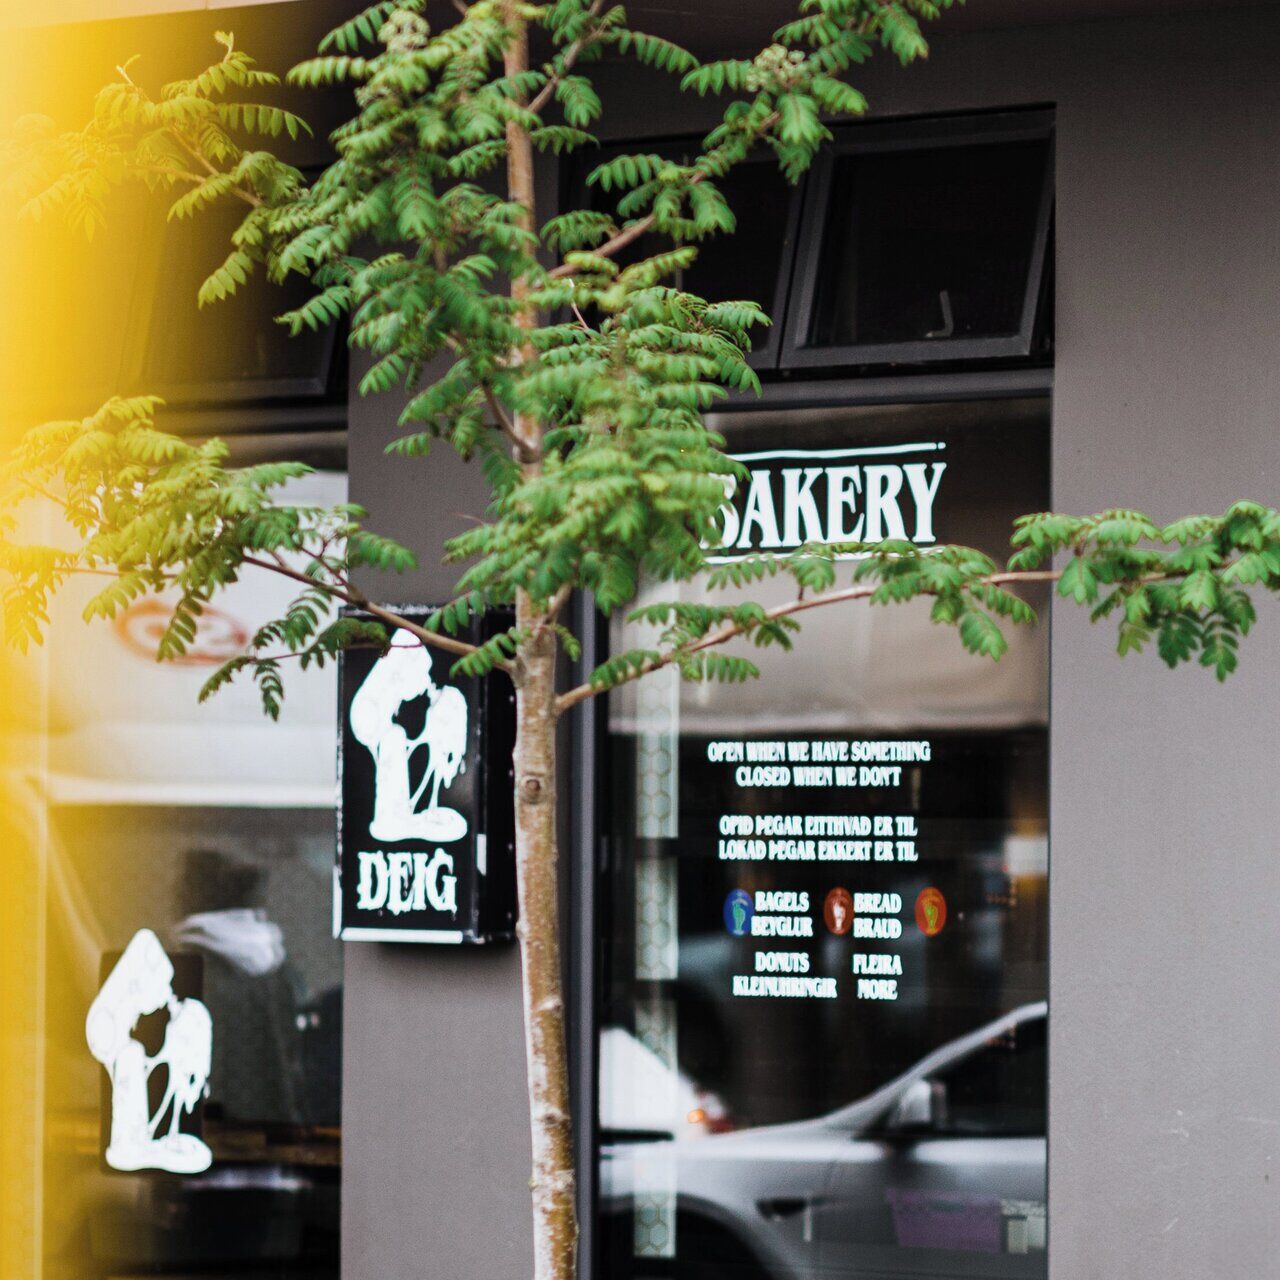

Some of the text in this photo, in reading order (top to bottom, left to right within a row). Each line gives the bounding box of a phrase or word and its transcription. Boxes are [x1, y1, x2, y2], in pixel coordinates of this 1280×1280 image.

[708, 741, 930, 762] OPEN WHEN WE HAVE SOMETHING
[736, 766, 790, 786] CLOSED
[793, 767, 832, 786] WHEN
[835, 767, 857, 786] WE
[874, 816, 893, 836] ER
[895, 817, 918, 836] TIL
[874, 841, 894, 861] ER
[896, 842, 918, 861] TIL
[357, 848, 457, 915] DEIG
[755, 892, 809, 912] BAGELS
[854, 893, 901, 913] BREAD
[751, 916, 813, 936] BEYGLUR
[755, 952, 809, 972] DONUTS
[853, 954, 902, 975] FLEIRA
[858, 979, 897, 1000] MORE
